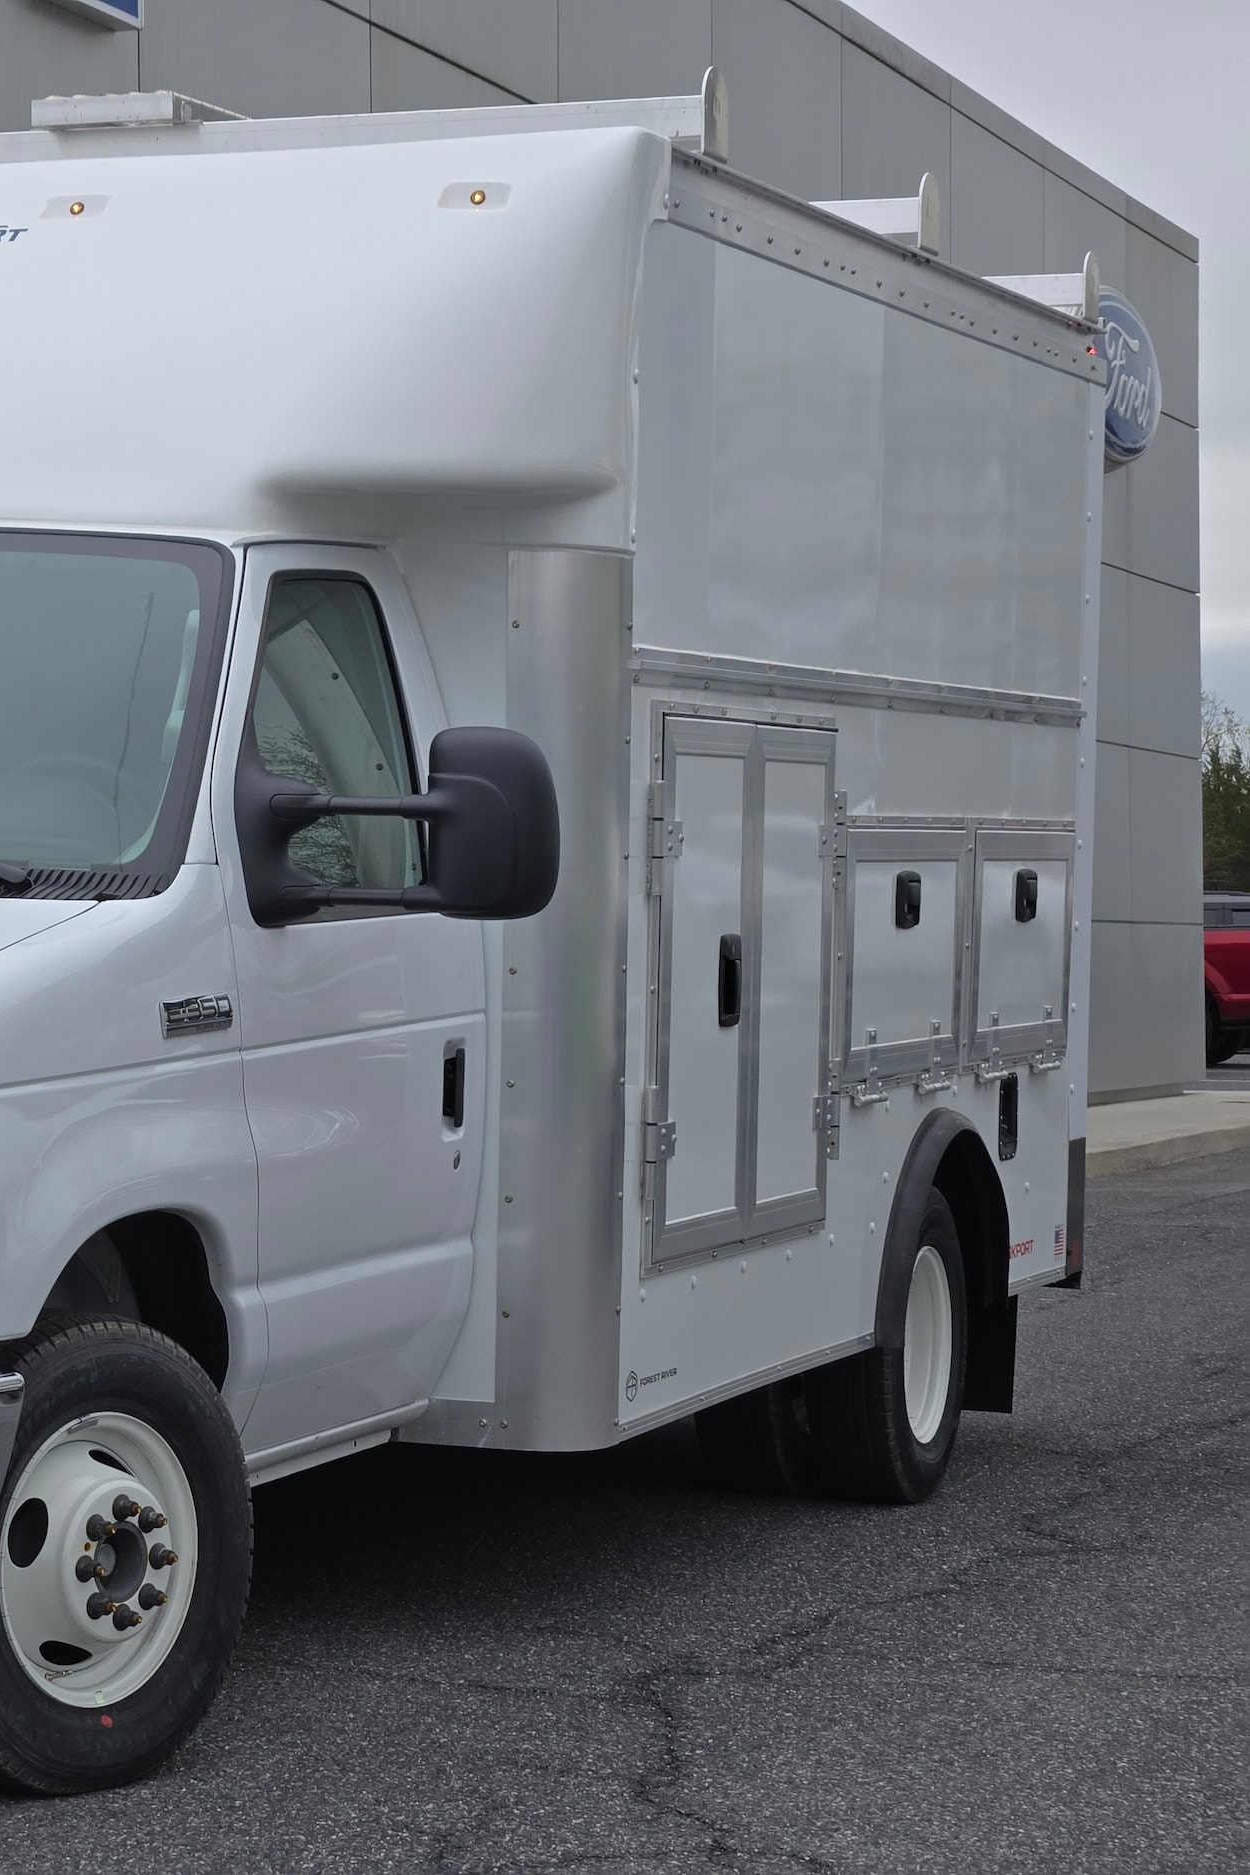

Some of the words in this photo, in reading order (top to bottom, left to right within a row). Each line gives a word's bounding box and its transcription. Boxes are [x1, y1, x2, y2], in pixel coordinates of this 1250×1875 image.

[1104, 321, 1151, 429] Ford
[639, 1372, 660, 1387] FOREST
[661, 1367, 677, 1380] RIVER
